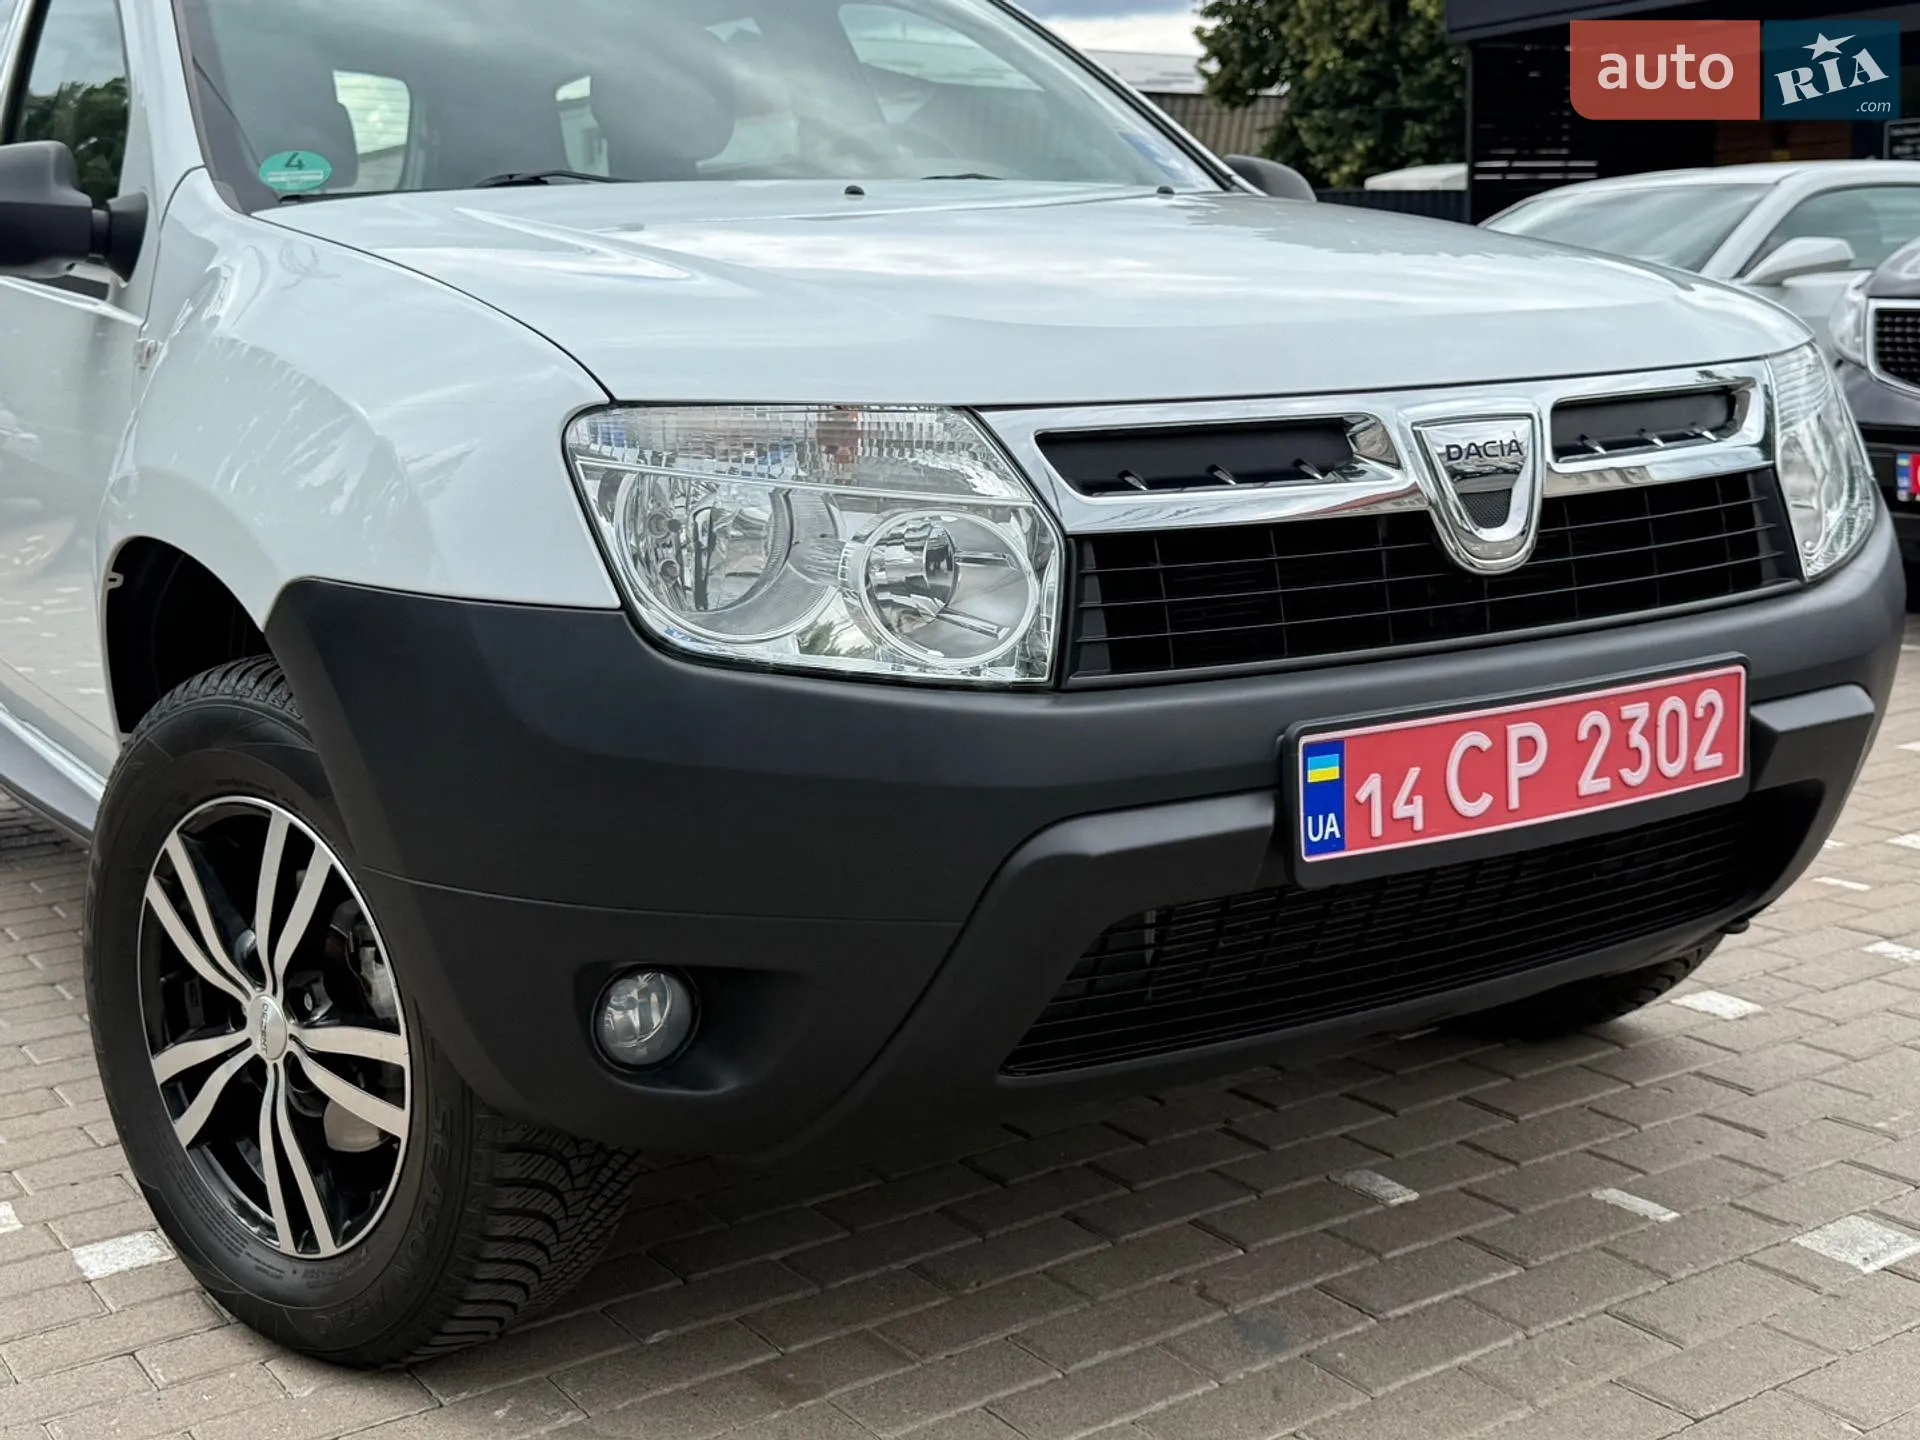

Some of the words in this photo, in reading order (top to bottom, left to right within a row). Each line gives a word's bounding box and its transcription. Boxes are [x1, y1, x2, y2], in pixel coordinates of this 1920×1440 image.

[284, 151, 305, 171] 4
[1444, 438, 1524, 462] DACIA
[1355, 766, 1424, 839] 14
[1446, 721, 1549, 818] CP
[1577, 688, 1724, 798] 2302
[1307, 813, 1341, 842] UA
